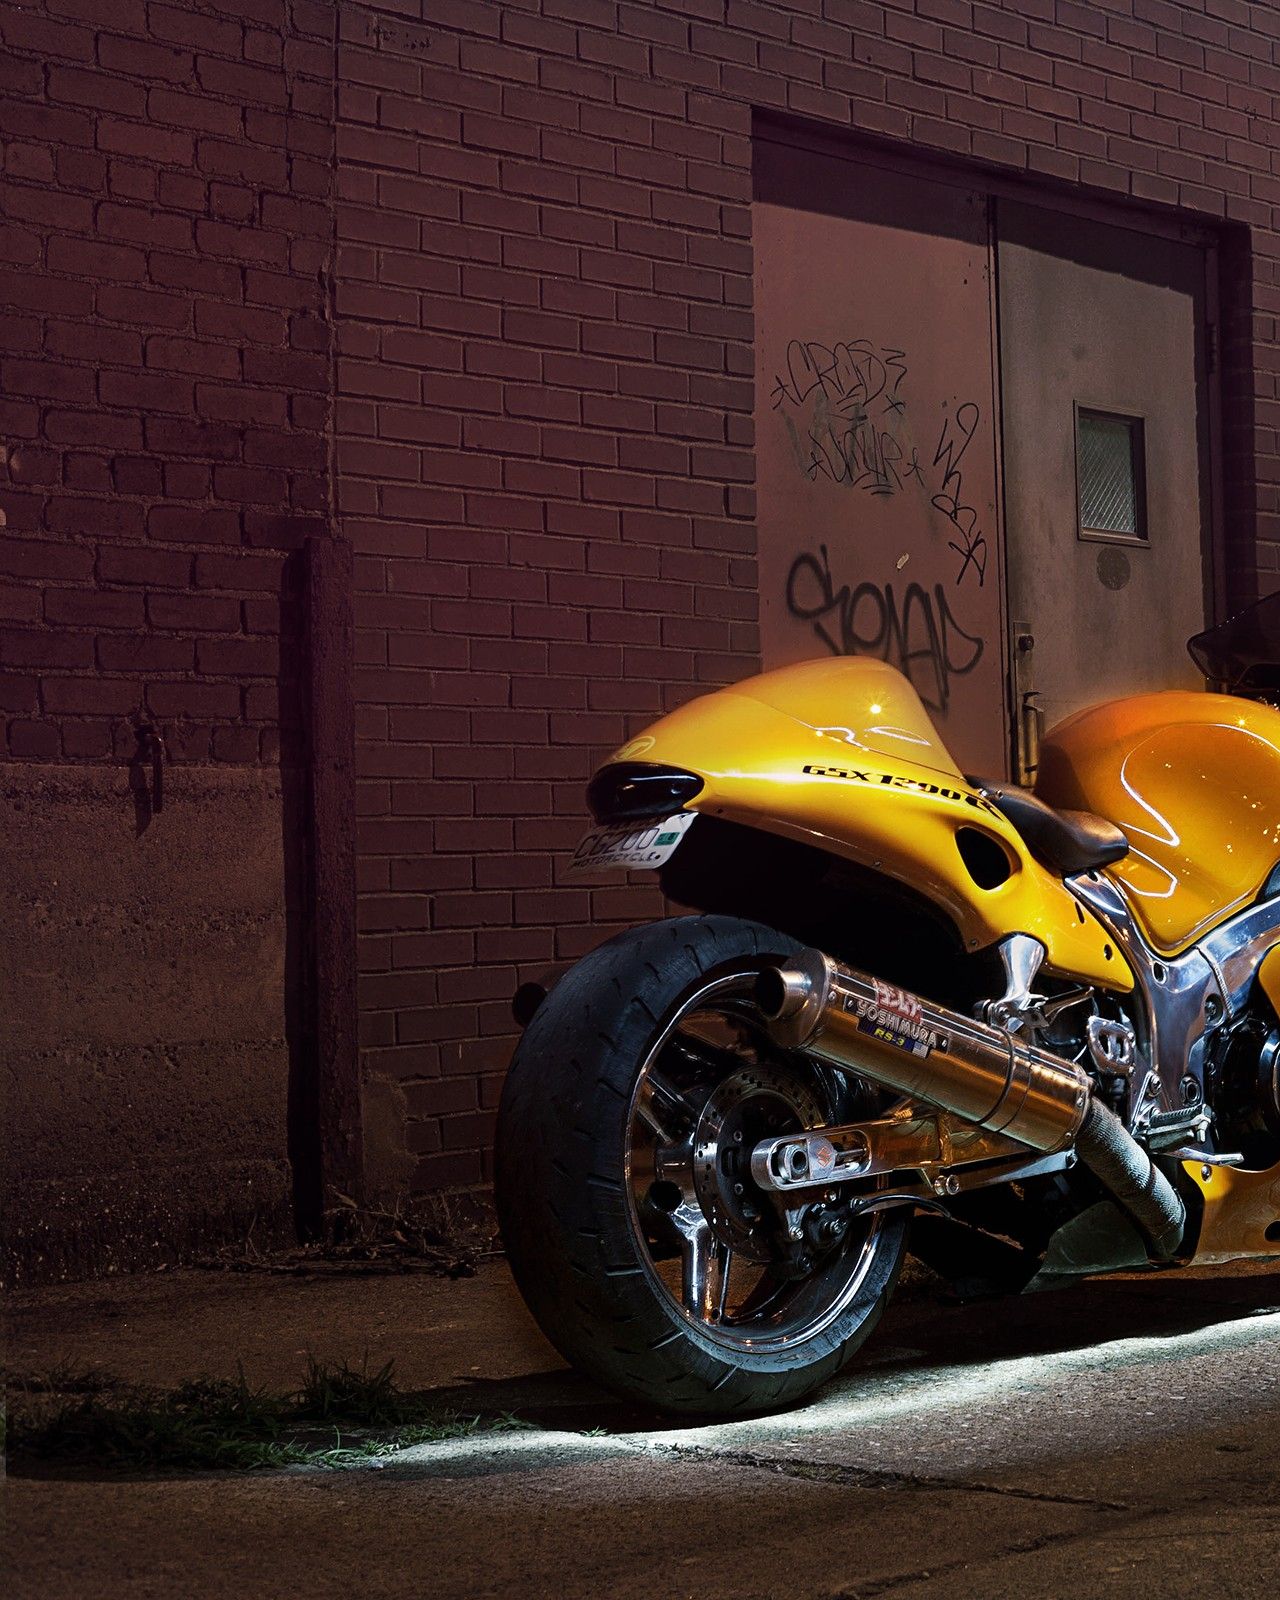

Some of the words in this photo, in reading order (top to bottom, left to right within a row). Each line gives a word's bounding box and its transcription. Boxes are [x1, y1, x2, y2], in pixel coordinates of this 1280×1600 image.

[802, 765, 870, 783] GSX
[856, 999, 937, 1049] YOSHIMURA
[874, 1028, 905, 1046] RS-3
